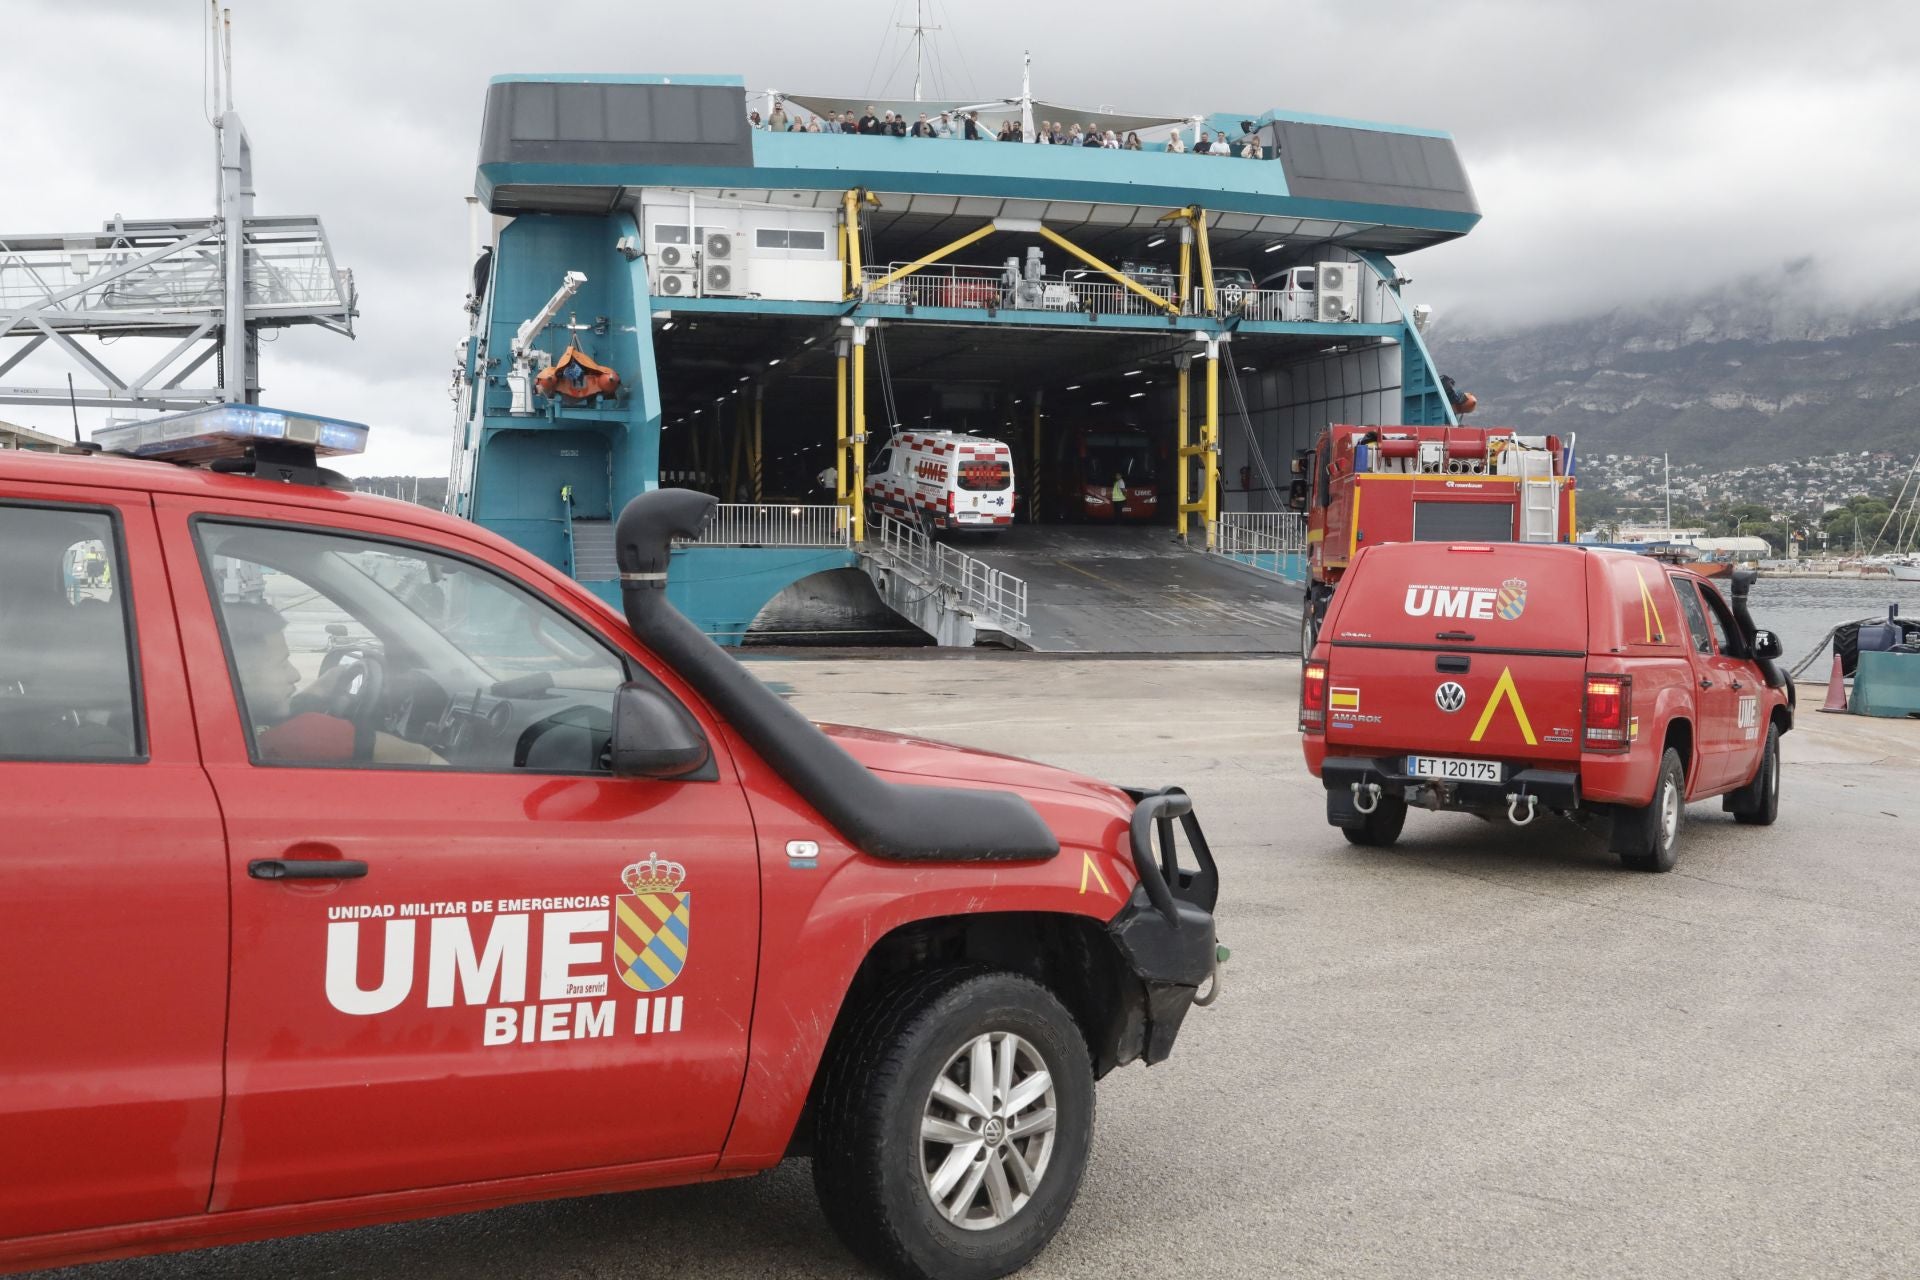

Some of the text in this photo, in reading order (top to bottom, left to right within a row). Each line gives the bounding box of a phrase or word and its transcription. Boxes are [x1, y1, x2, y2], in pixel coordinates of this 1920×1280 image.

[918, 460, 948, 482] UME
[1404, 588, 1497, 620] UME
[1332, 713, 1382, 723] AMAROK
[1418, 758, 1496, 780] ET 120175
[328, 895, 610, 920] UNIDAD MILITAR DE EMERGENCIAS
[325, 910, 610, 1016] UME
[585, 981, 606, 993] servir!
[483, 995, 684, 1047] BIEM III
